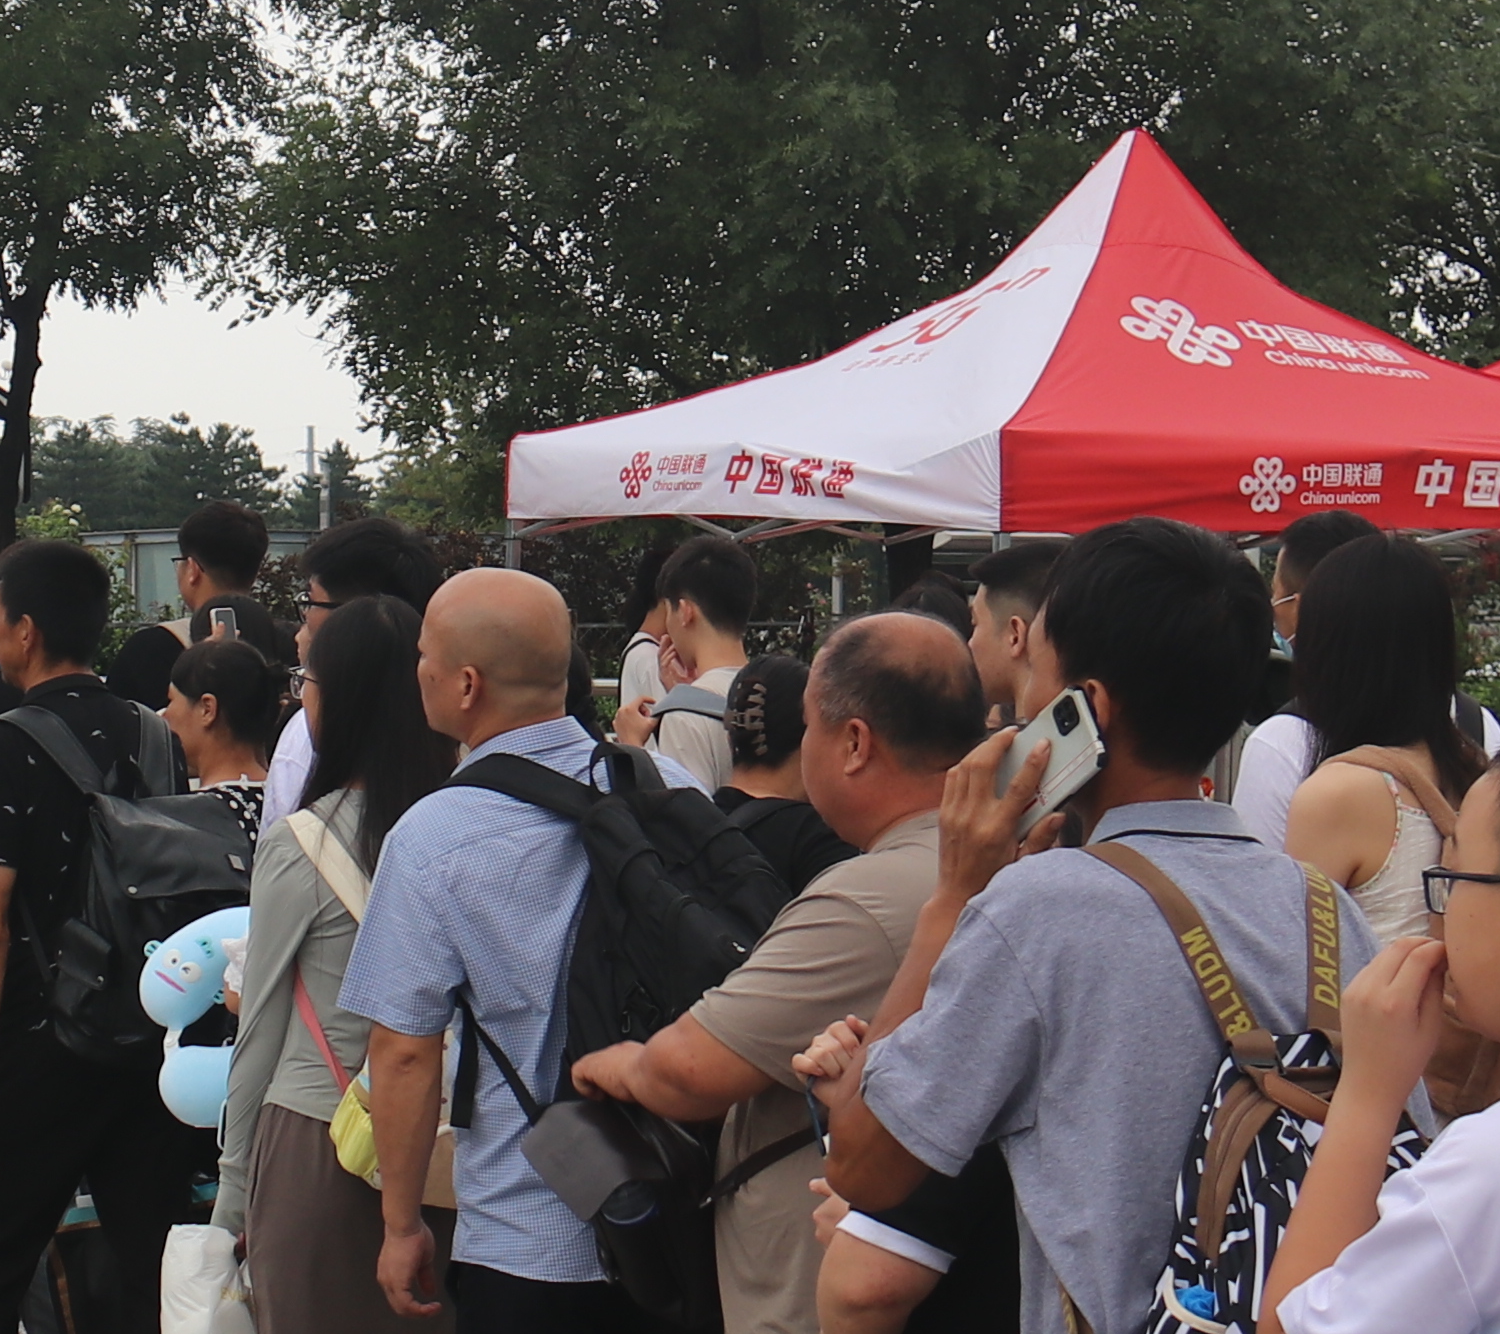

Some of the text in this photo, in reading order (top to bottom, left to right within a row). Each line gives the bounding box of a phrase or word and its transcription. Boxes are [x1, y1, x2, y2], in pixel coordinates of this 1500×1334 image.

[1236, 319, 1410, 366] 中国联通
[1264, 350, 1430, 380] China unicom
[656, 453, 708, 475] 中国联通
[723, 450, 857, 498] 中国联通
[1302, 462, 1383, 488] 中国联通
[652, 479, 703, 492] China unicom
[1300, 491, 1380, 506] China unicom
